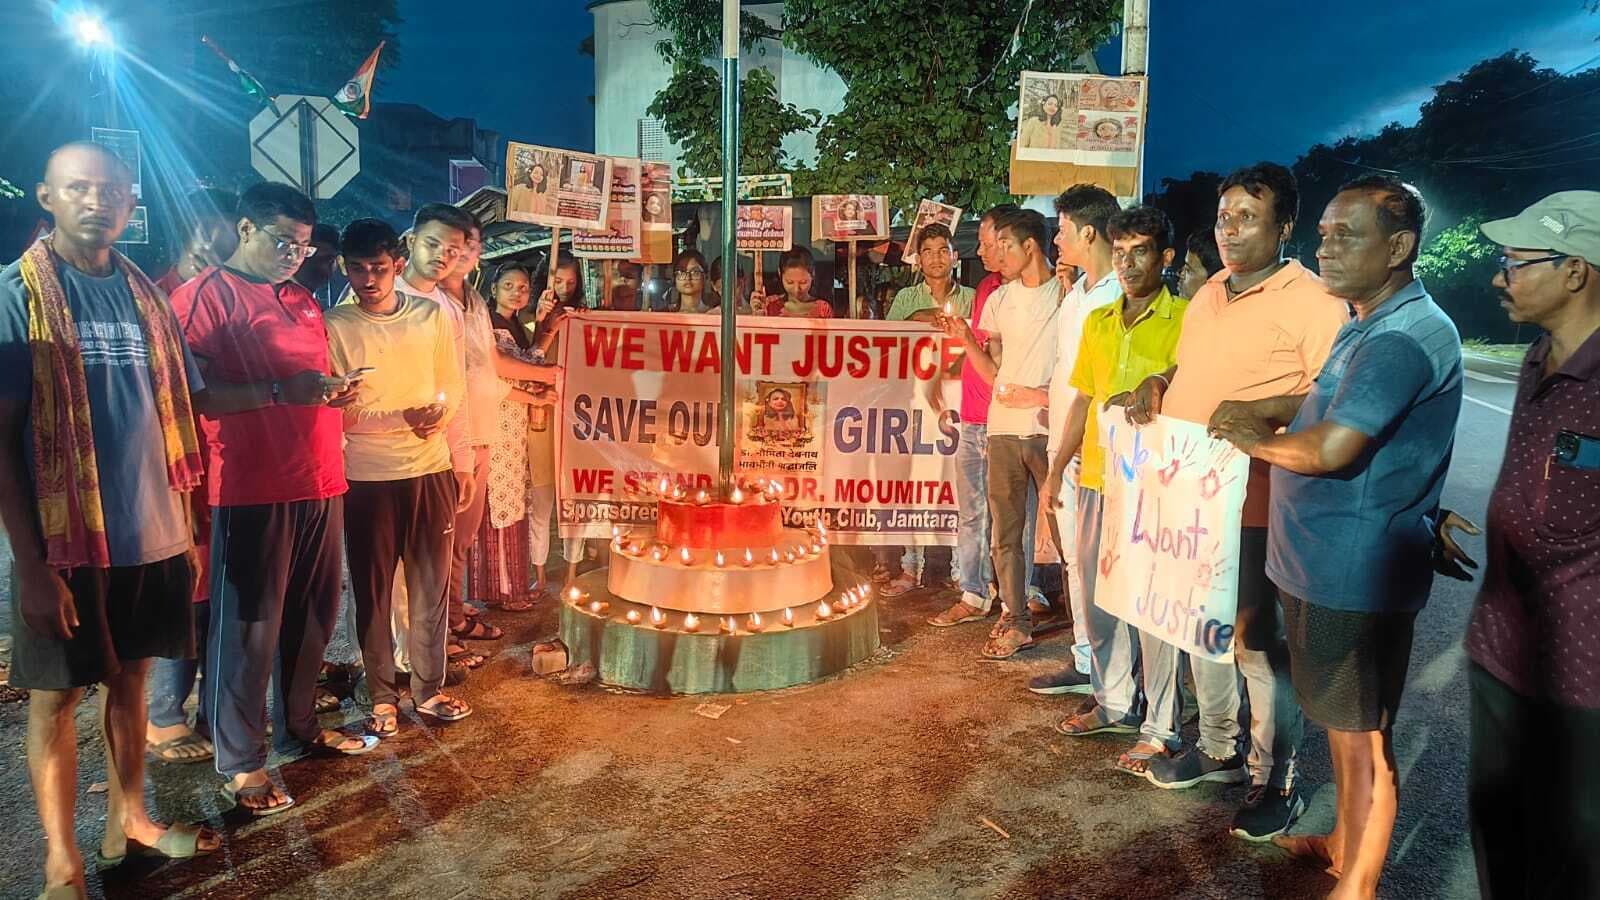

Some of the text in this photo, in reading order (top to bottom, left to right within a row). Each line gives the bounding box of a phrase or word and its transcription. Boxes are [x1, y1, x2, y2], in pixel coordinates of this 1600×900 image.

[583, 324, 965, 380] WE WANT JUSTICE
[572, 393, 961, 456] SAVE OU GIRLS
[572, 468, 614, 495] WE
[783, 477, 825, 502] DR.
[834, 479, 955, 505] MOUMITA
[781, 508, 834, 529] Youth
[836, 508, 882, 531] Club,
[886, 511, 959, 530] Jamtara
[1131, 488, 1208, 561] Want
